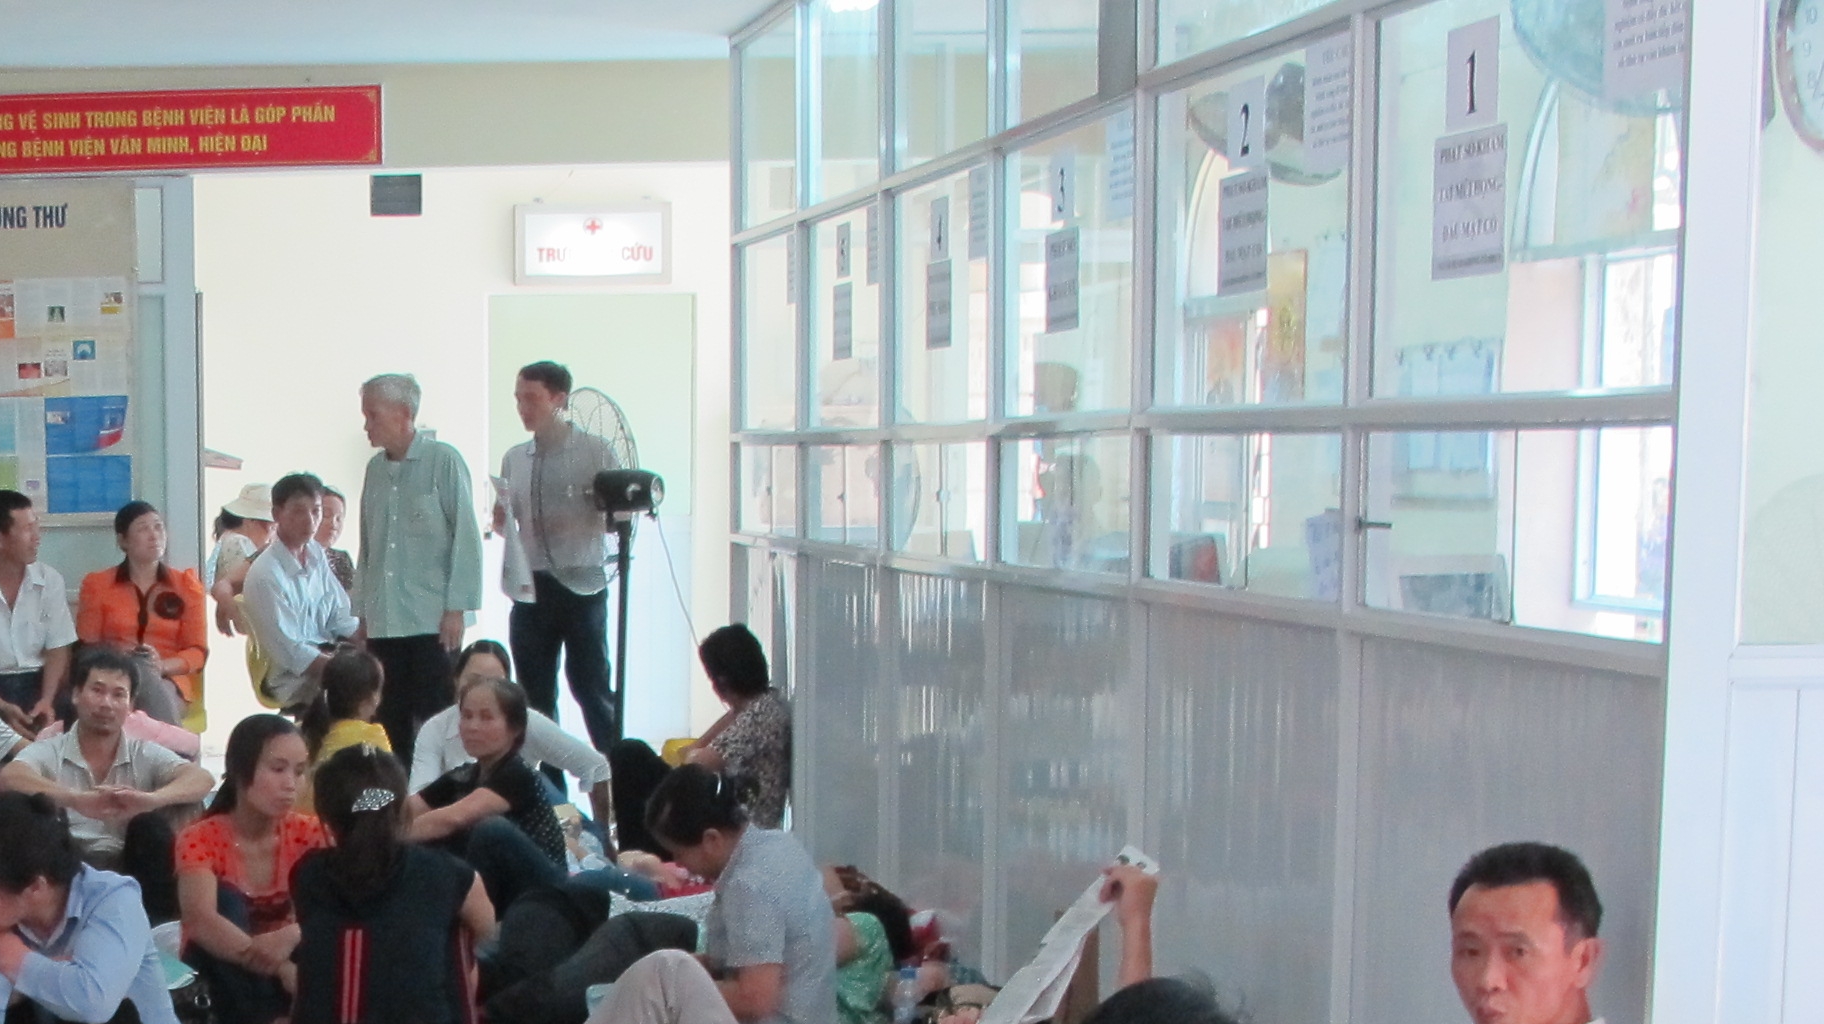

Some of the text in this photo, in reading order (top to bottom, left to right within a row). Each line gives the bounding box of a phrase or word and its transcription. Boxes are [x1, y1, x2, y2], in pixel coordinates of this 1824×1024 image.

[1465, 49, 1476, 116] 1
[19, 109, 37, 133] VỆ
[43, 112, 80, 130] SINH
[85, 110, 137, 129] TRONG
[142, 106, 184, 129] BỆNH
[190, 104, 225, 129] VIỆN
[231, 104, 249, 124] LÀ
[255, 103, 286, 124] GÓP
[291, 100, 335, 123] PHẦN
[1240, 102, 1250, 157] 2
[21, 137, 64, 161] BỆNH
[69, 136, 105, 160] VIỆN
[109, 135, 142, 155] VĂN
[147, 137, 194, 156] MINH,
[199, 132, 236, 156] HIỆN
[241, 135, 268, 156] ĐẠI
[1057, 166, 1066, 214] 3
[33, 203, 68, 228] THƯ
[622, 242, 653, 261] CỨU
